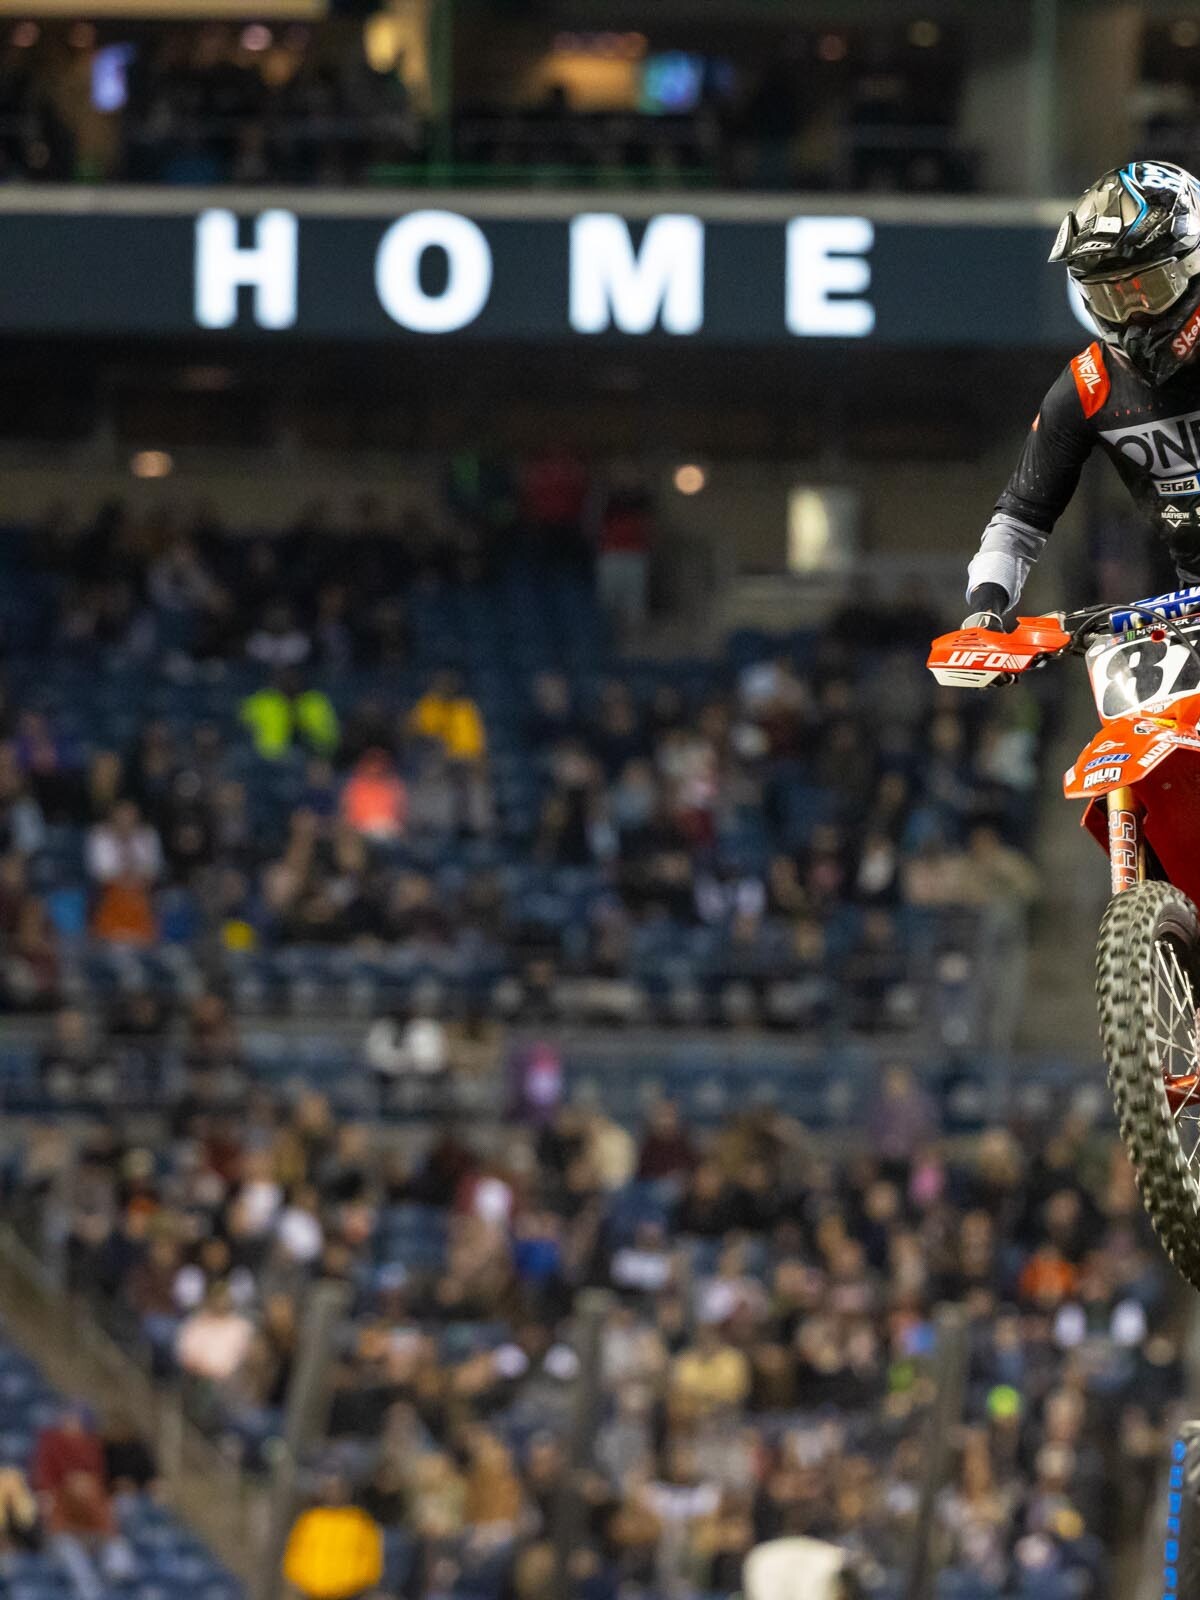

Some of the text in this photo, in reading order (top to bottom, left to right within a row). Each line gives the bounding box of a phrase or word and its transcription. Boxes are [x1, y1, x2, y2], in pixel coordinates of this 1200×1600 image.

[194, 208, 875, 338] HOME
[1160, 479, 1196, 492] SGB
[1160, 511, 1191, 520] MAYHEW
[1136, 618, 1190, 636] MONSER
[946, 650, 1010, 668] UFO
